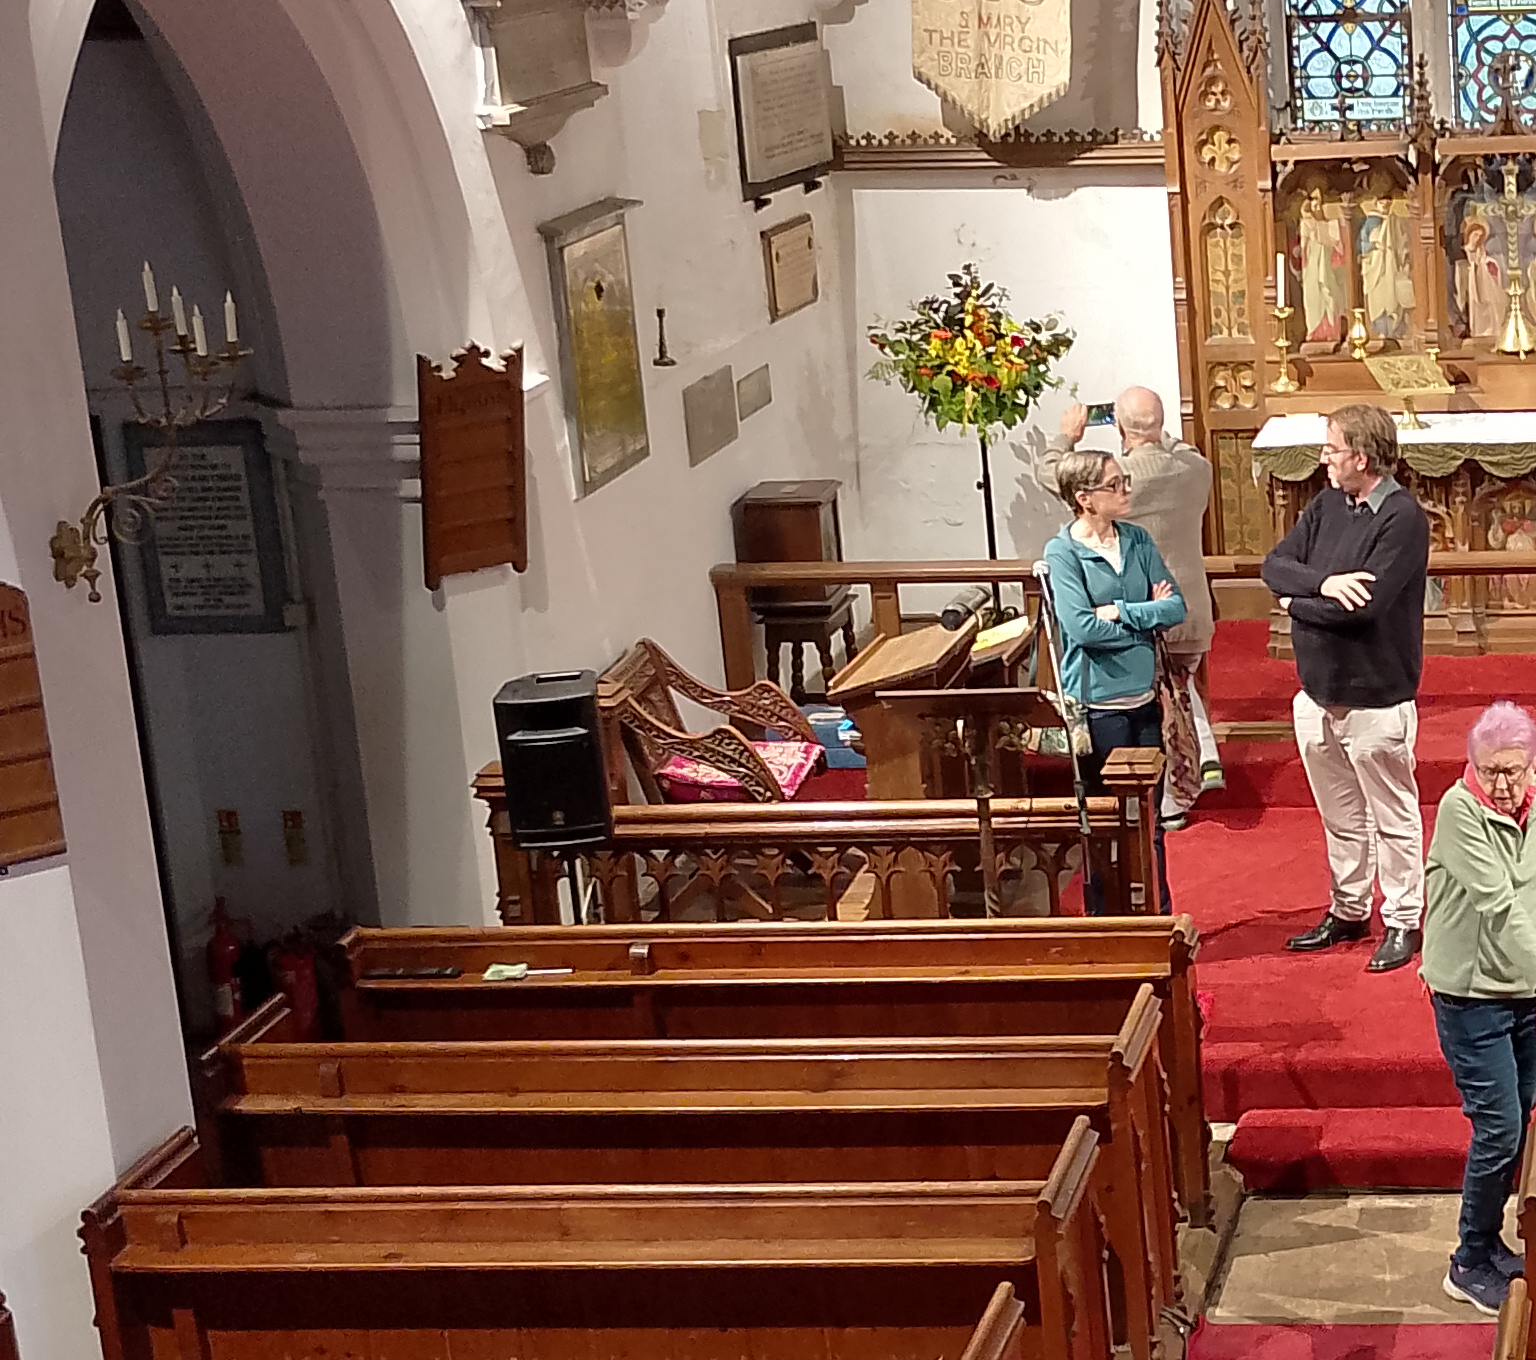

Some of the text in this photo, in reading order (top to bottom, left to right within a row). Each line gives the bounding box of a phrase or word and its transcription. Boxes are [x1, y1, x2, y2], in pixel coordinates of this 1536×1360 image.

[977, 11, 1032, 35] MARY
[923, 28, 971, 49] THE
[937, 50, 1046, 85] BRANCH
